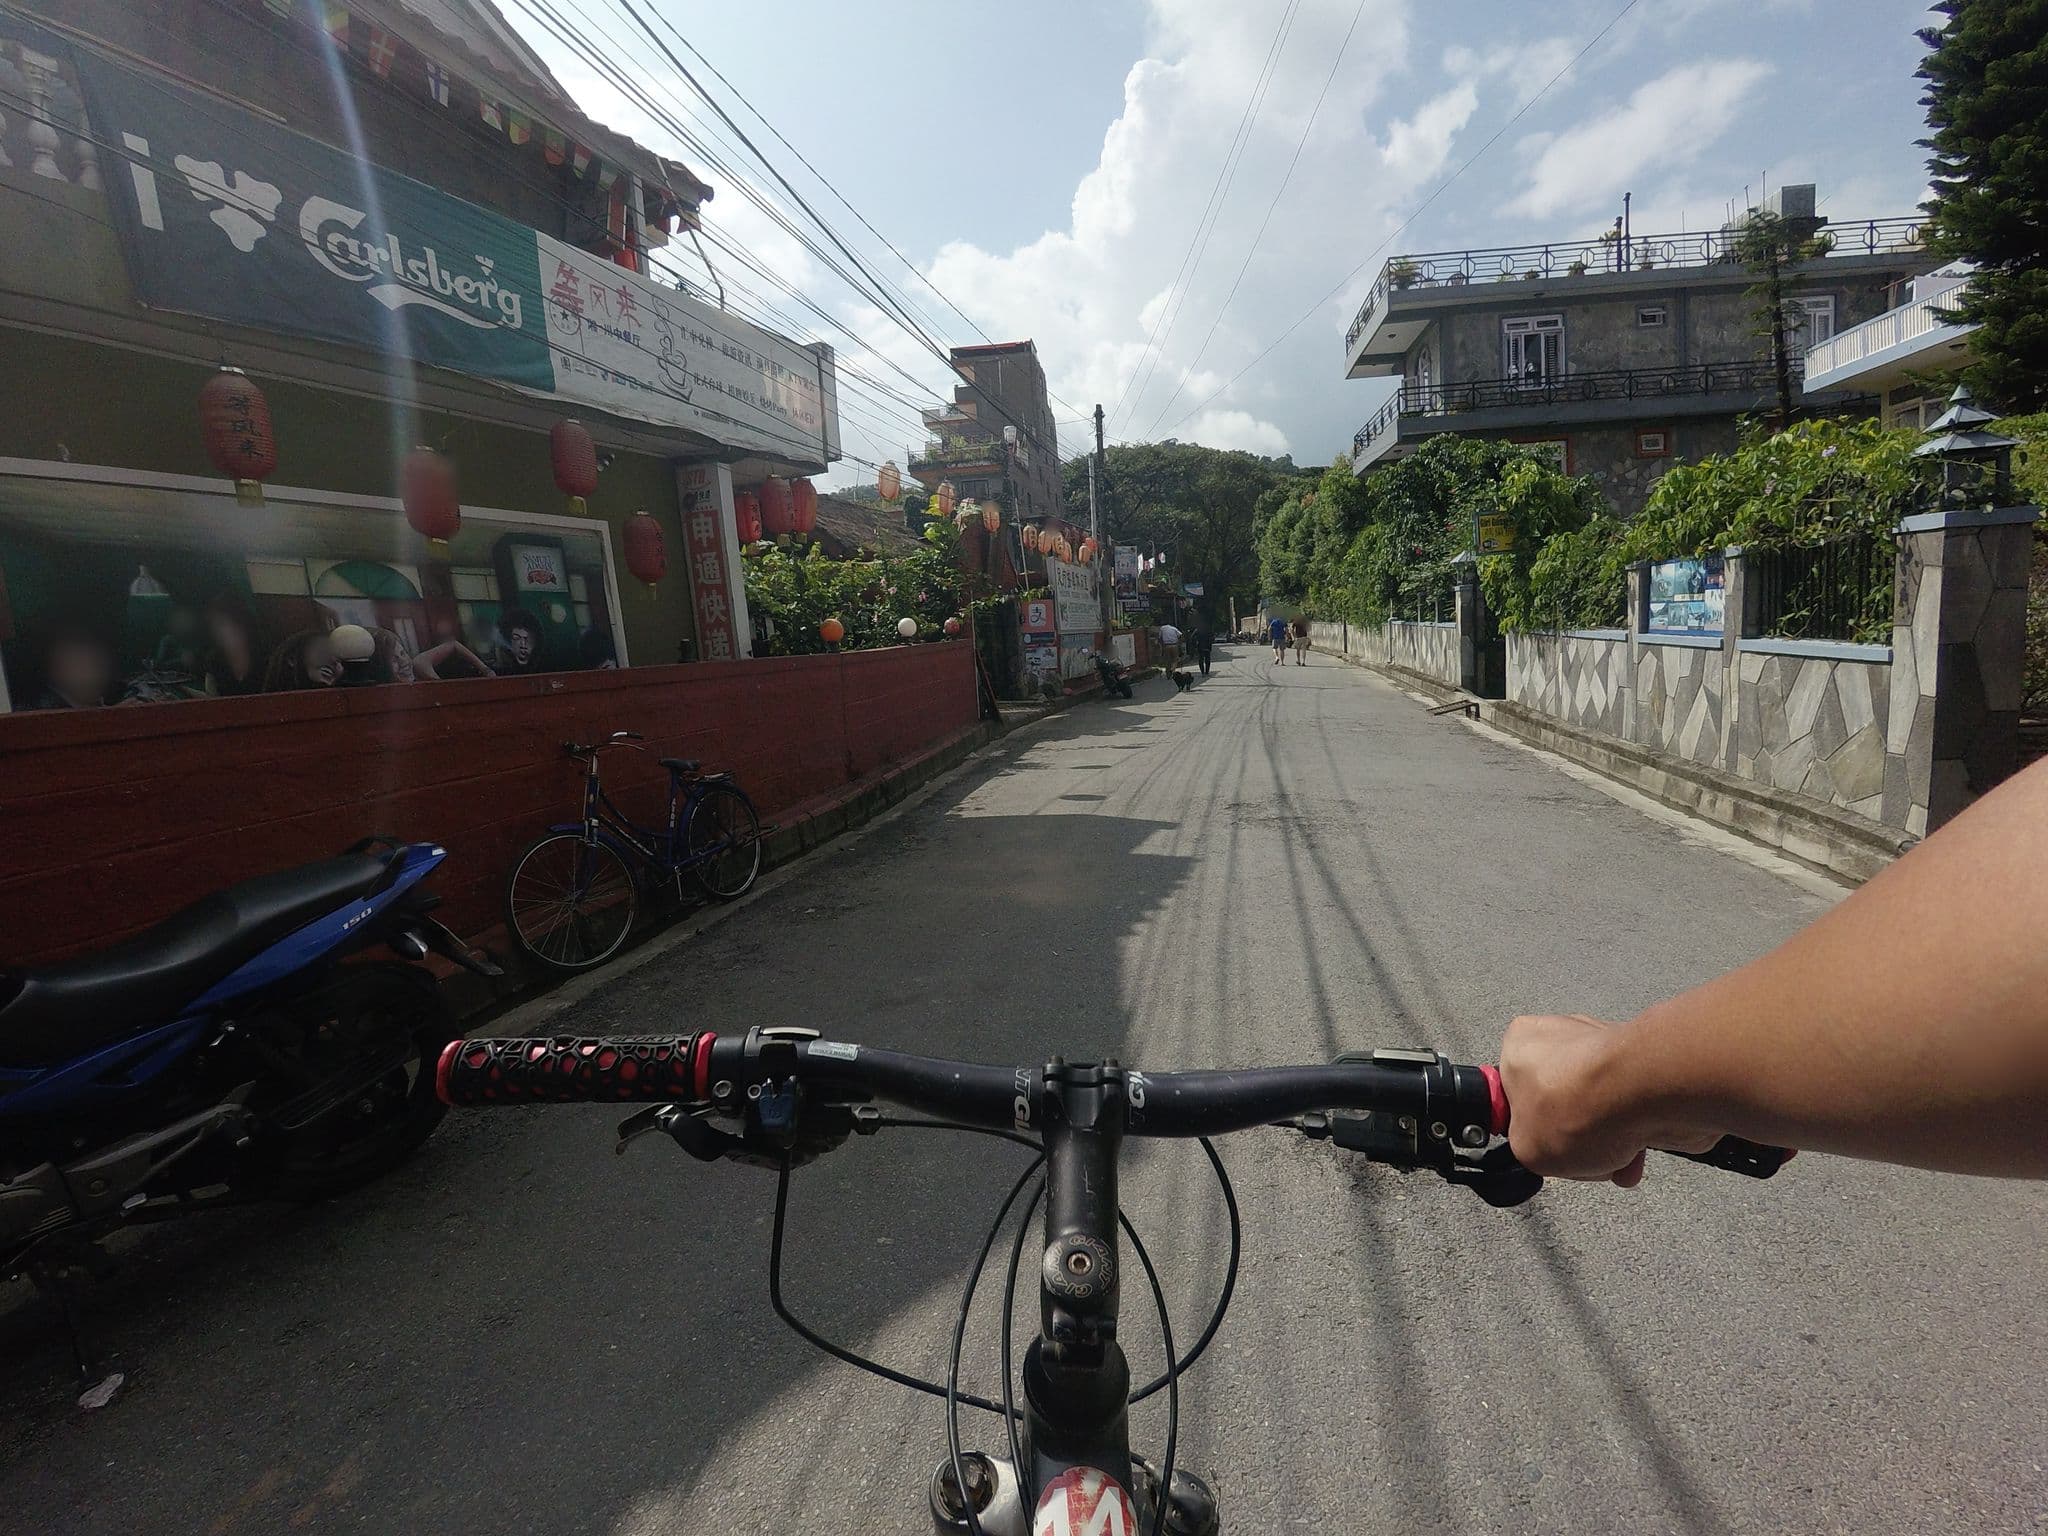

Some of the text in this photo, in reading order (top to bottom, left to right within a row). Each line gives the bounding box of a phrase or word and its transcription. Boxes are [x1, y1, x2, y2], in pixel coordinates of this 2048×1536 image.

[123, 131, 522, 330] I Carlsberg
[342, 907, 372, 930] 150
